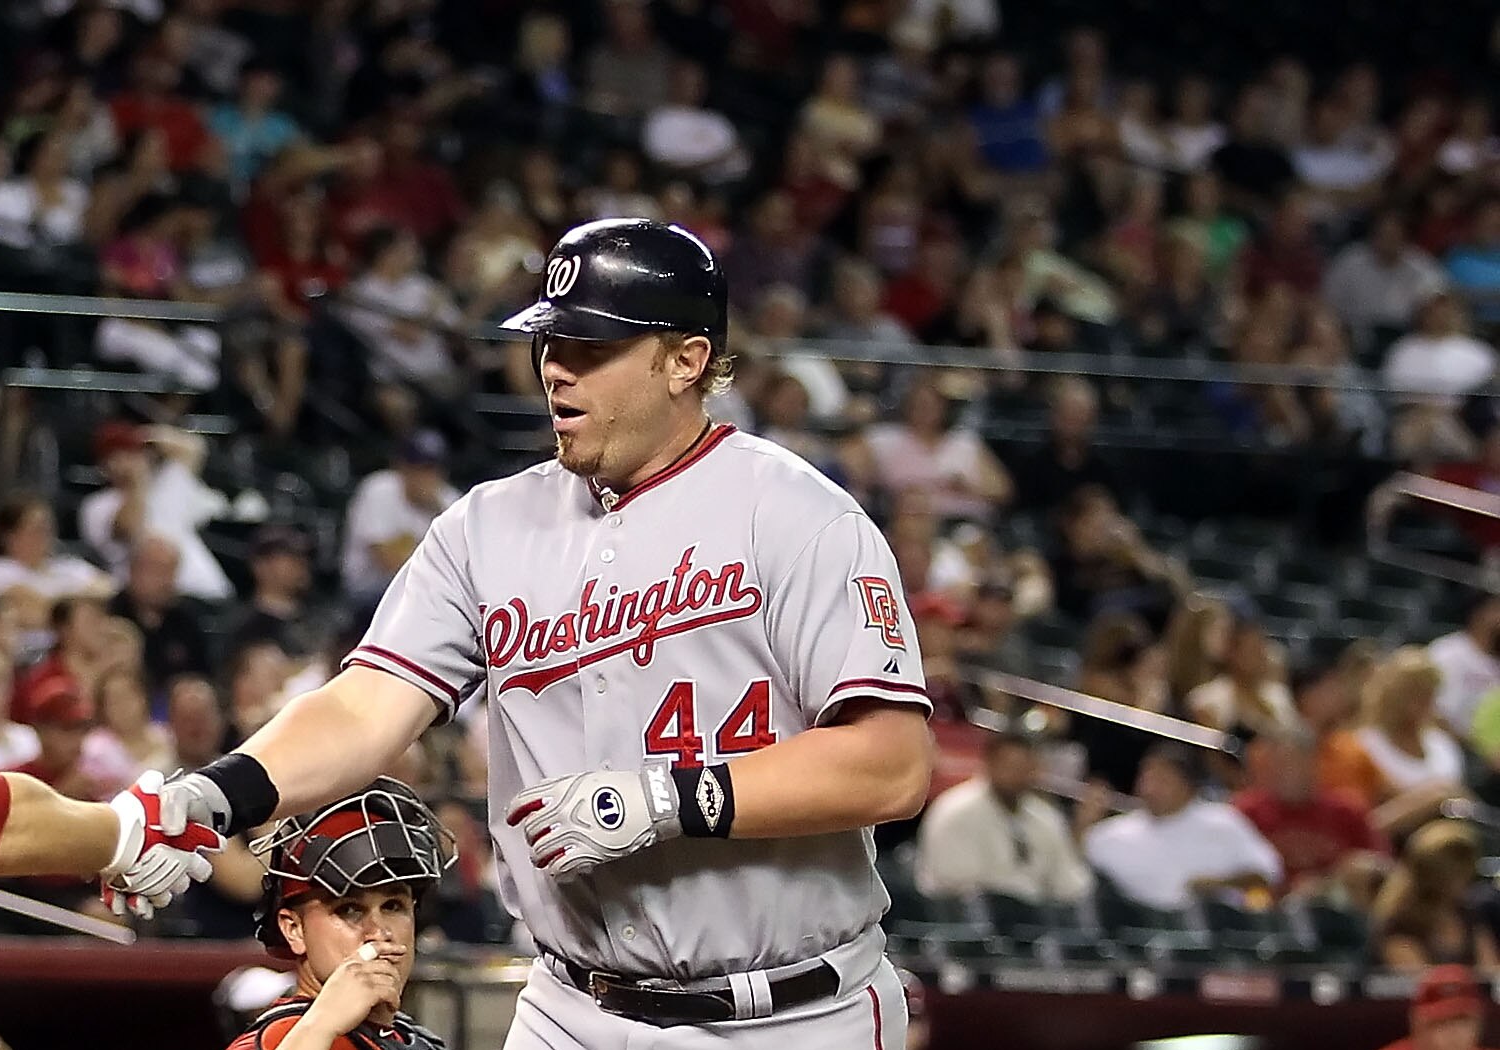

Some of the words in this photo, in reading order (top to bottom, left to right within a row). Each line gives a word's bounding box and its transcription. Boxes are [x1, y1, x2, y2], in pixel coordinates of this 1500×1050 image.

[547, 255, 580, 298] W
[479, 542, 763, 696] Washington
[642, 677, 779, 768] 44
[647, 765, 673, 814] TPX
